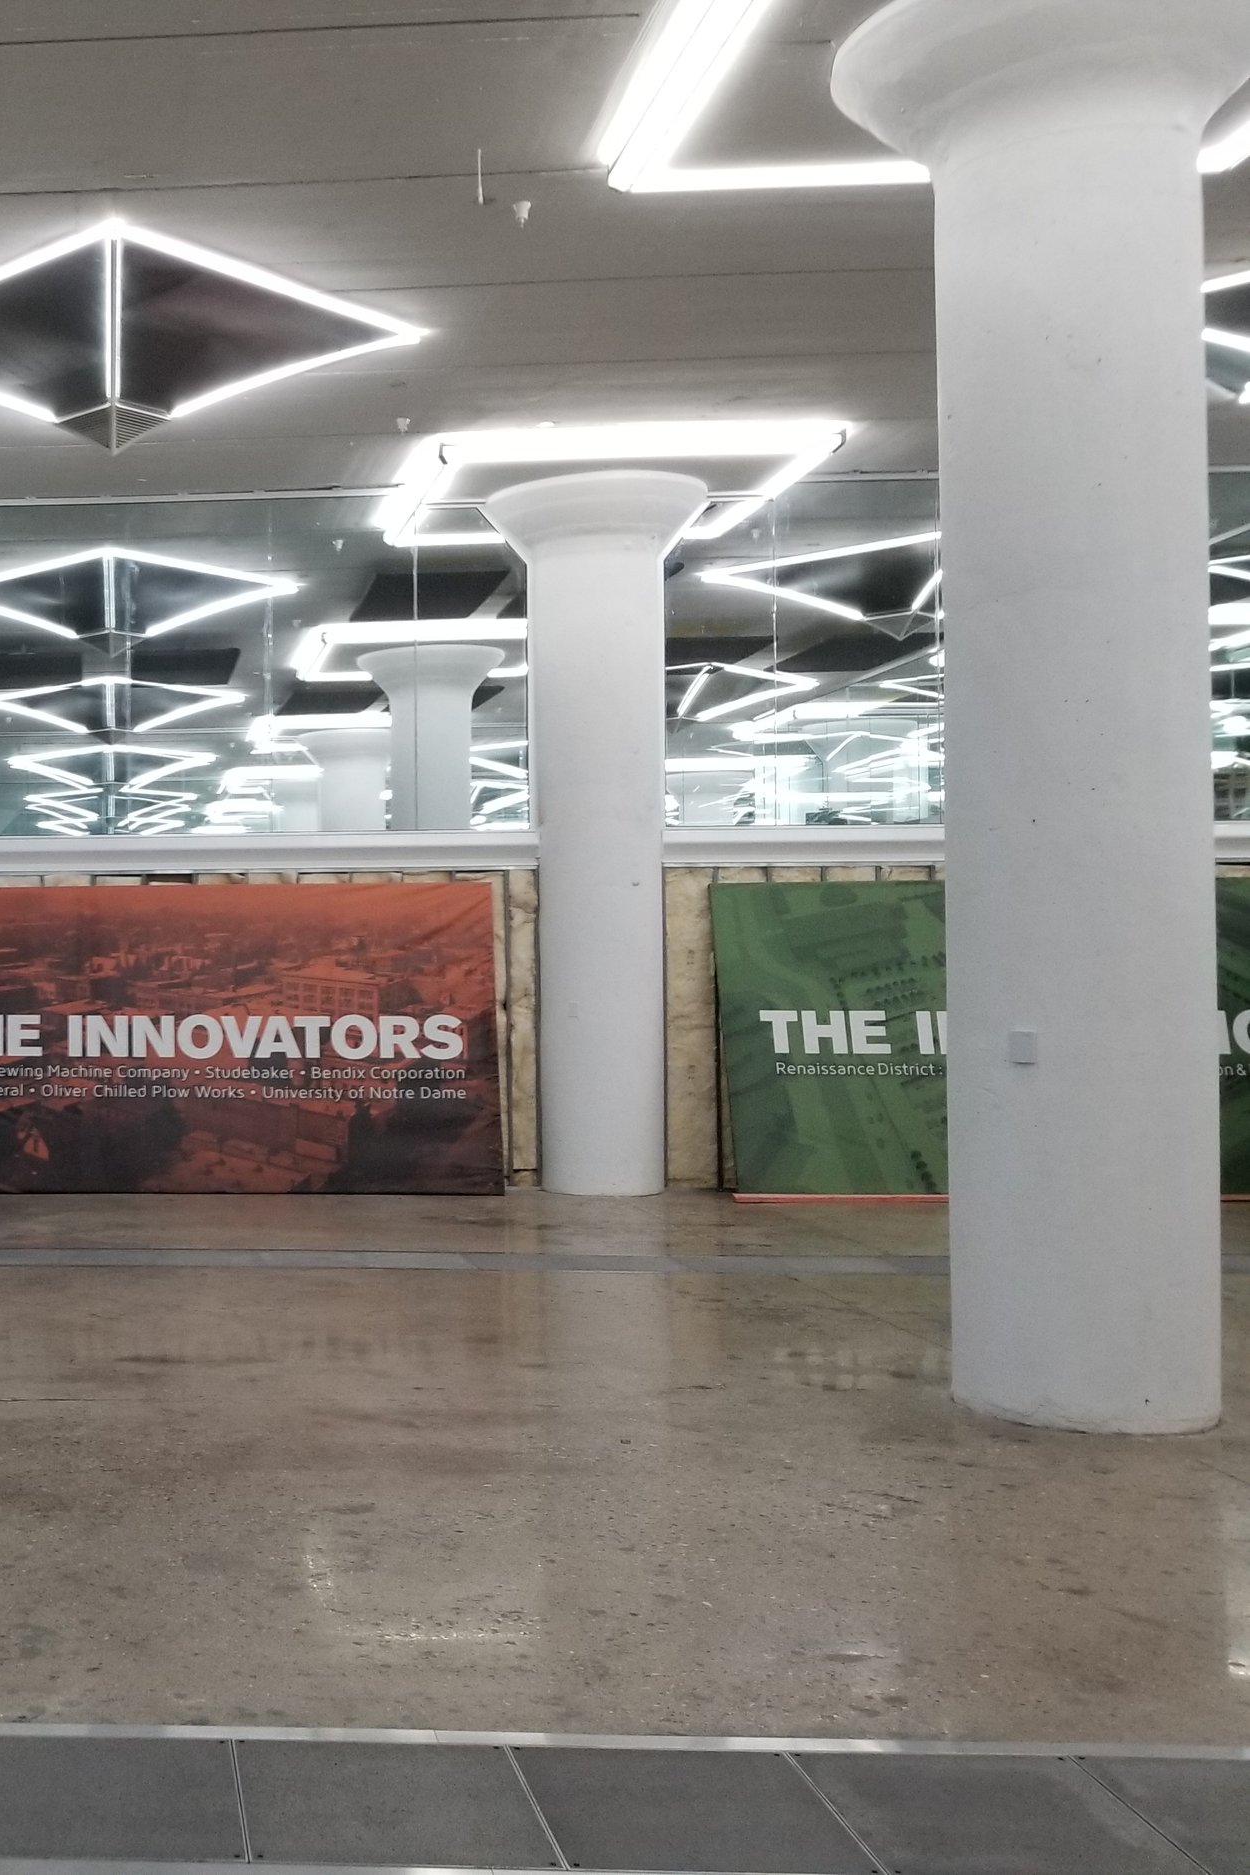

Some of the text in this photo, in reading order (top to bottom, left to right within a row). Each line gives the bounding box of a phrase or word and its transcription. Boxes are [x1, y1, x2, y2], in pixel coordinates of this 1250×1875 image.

[68, 1014, 464, 1060] INNOVATORS
[759, 1010, 892, 1055] THE
[47, 1064, 113, 1079] Machine
[116, 1065, 190, 1082] Company
[205, 1065, 296, 1080] Studebaker
[311, 1066, 366, 1080] Bendix
[370, 1066, 466, 1083] Corporation
[775, 1062, 875, 1076] Renaissance
[41, 1084, 88, 1098] Oliver
[93, 1084, 147, 1098] Chilled
[152, 1085, 191, 1099] Plow
[194, 1085, 245, 1099] Works
[262, 1085, 343, 1102] University
[348, 1085, 365, 1099] of
[369, 1086, 415, 1100] Notre
[420, 1086, 467, 1100] Dame
